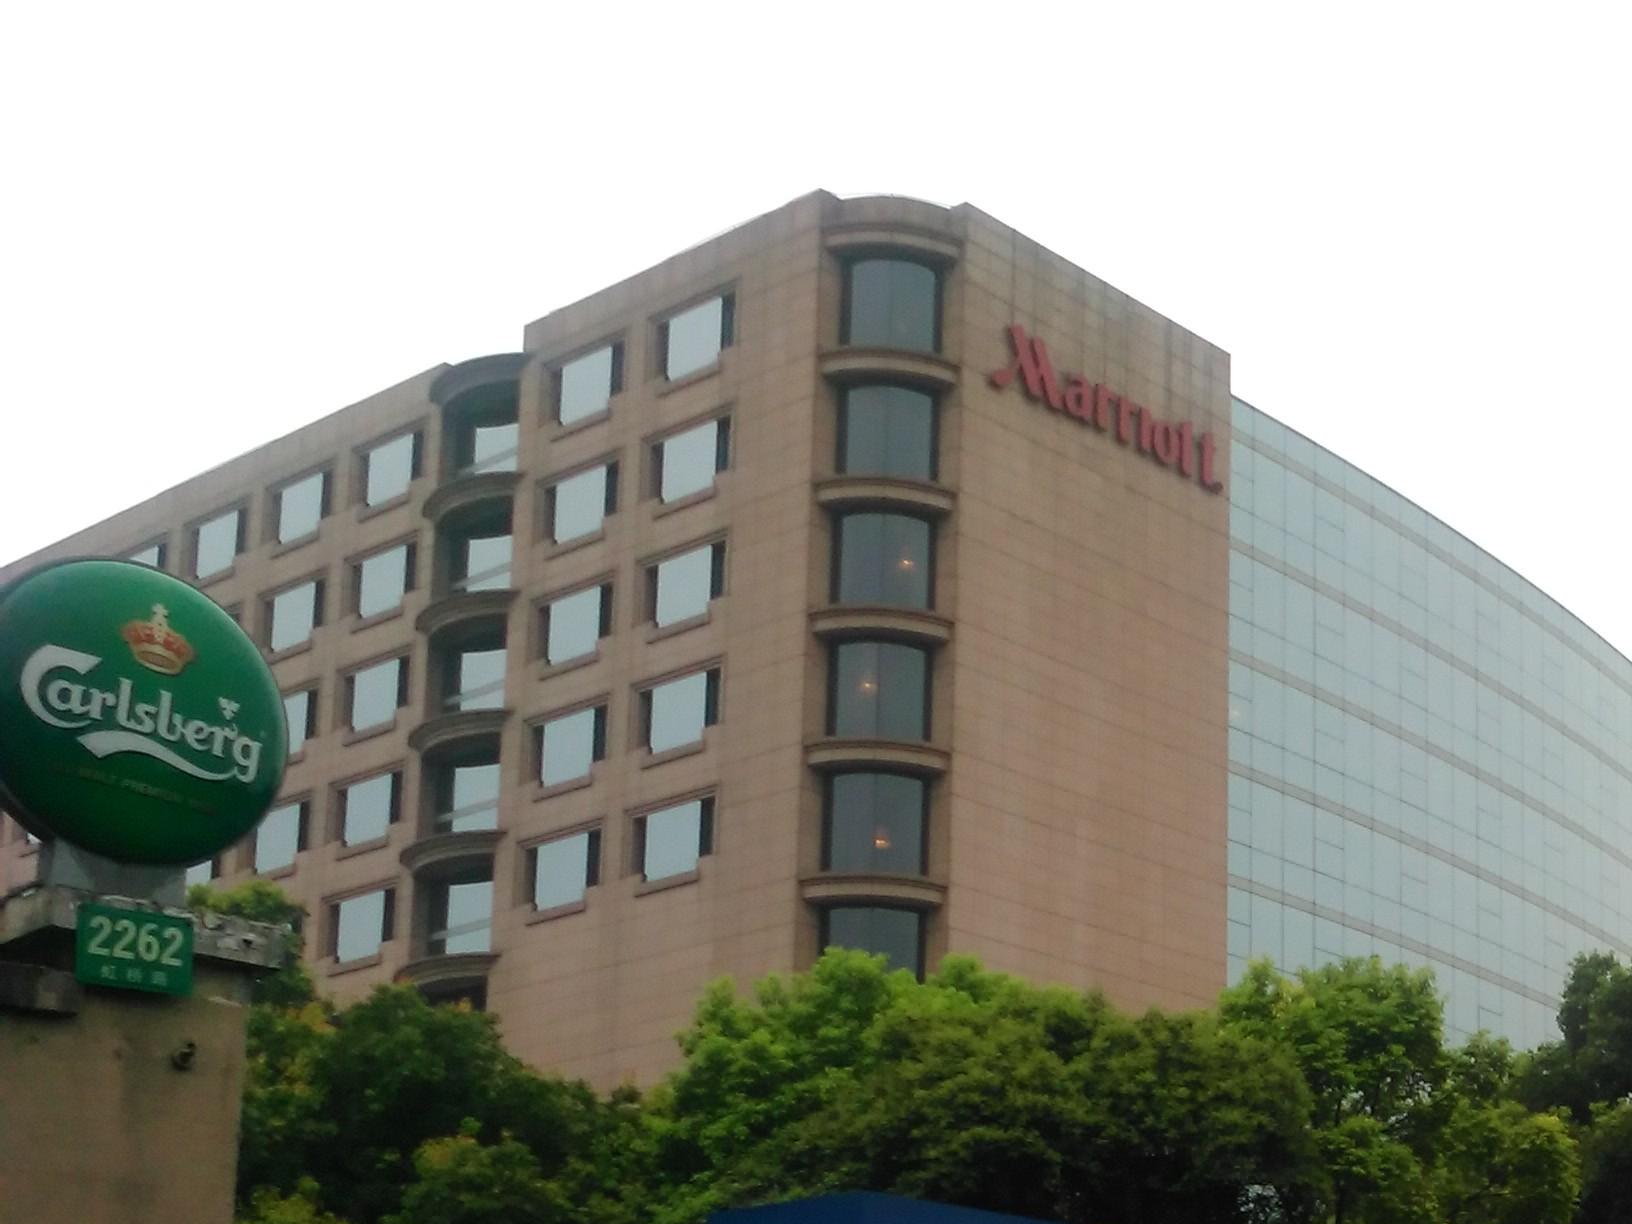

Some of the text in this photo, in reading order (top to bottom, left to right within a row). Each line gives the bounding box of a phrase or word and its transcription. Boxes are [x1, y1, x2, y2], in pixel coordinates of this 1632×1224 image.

[987, 324, 1223, 495] Marriott
[20, 643, 262, 784] Carlsberg
[87, 914, 184, 967] 2262
